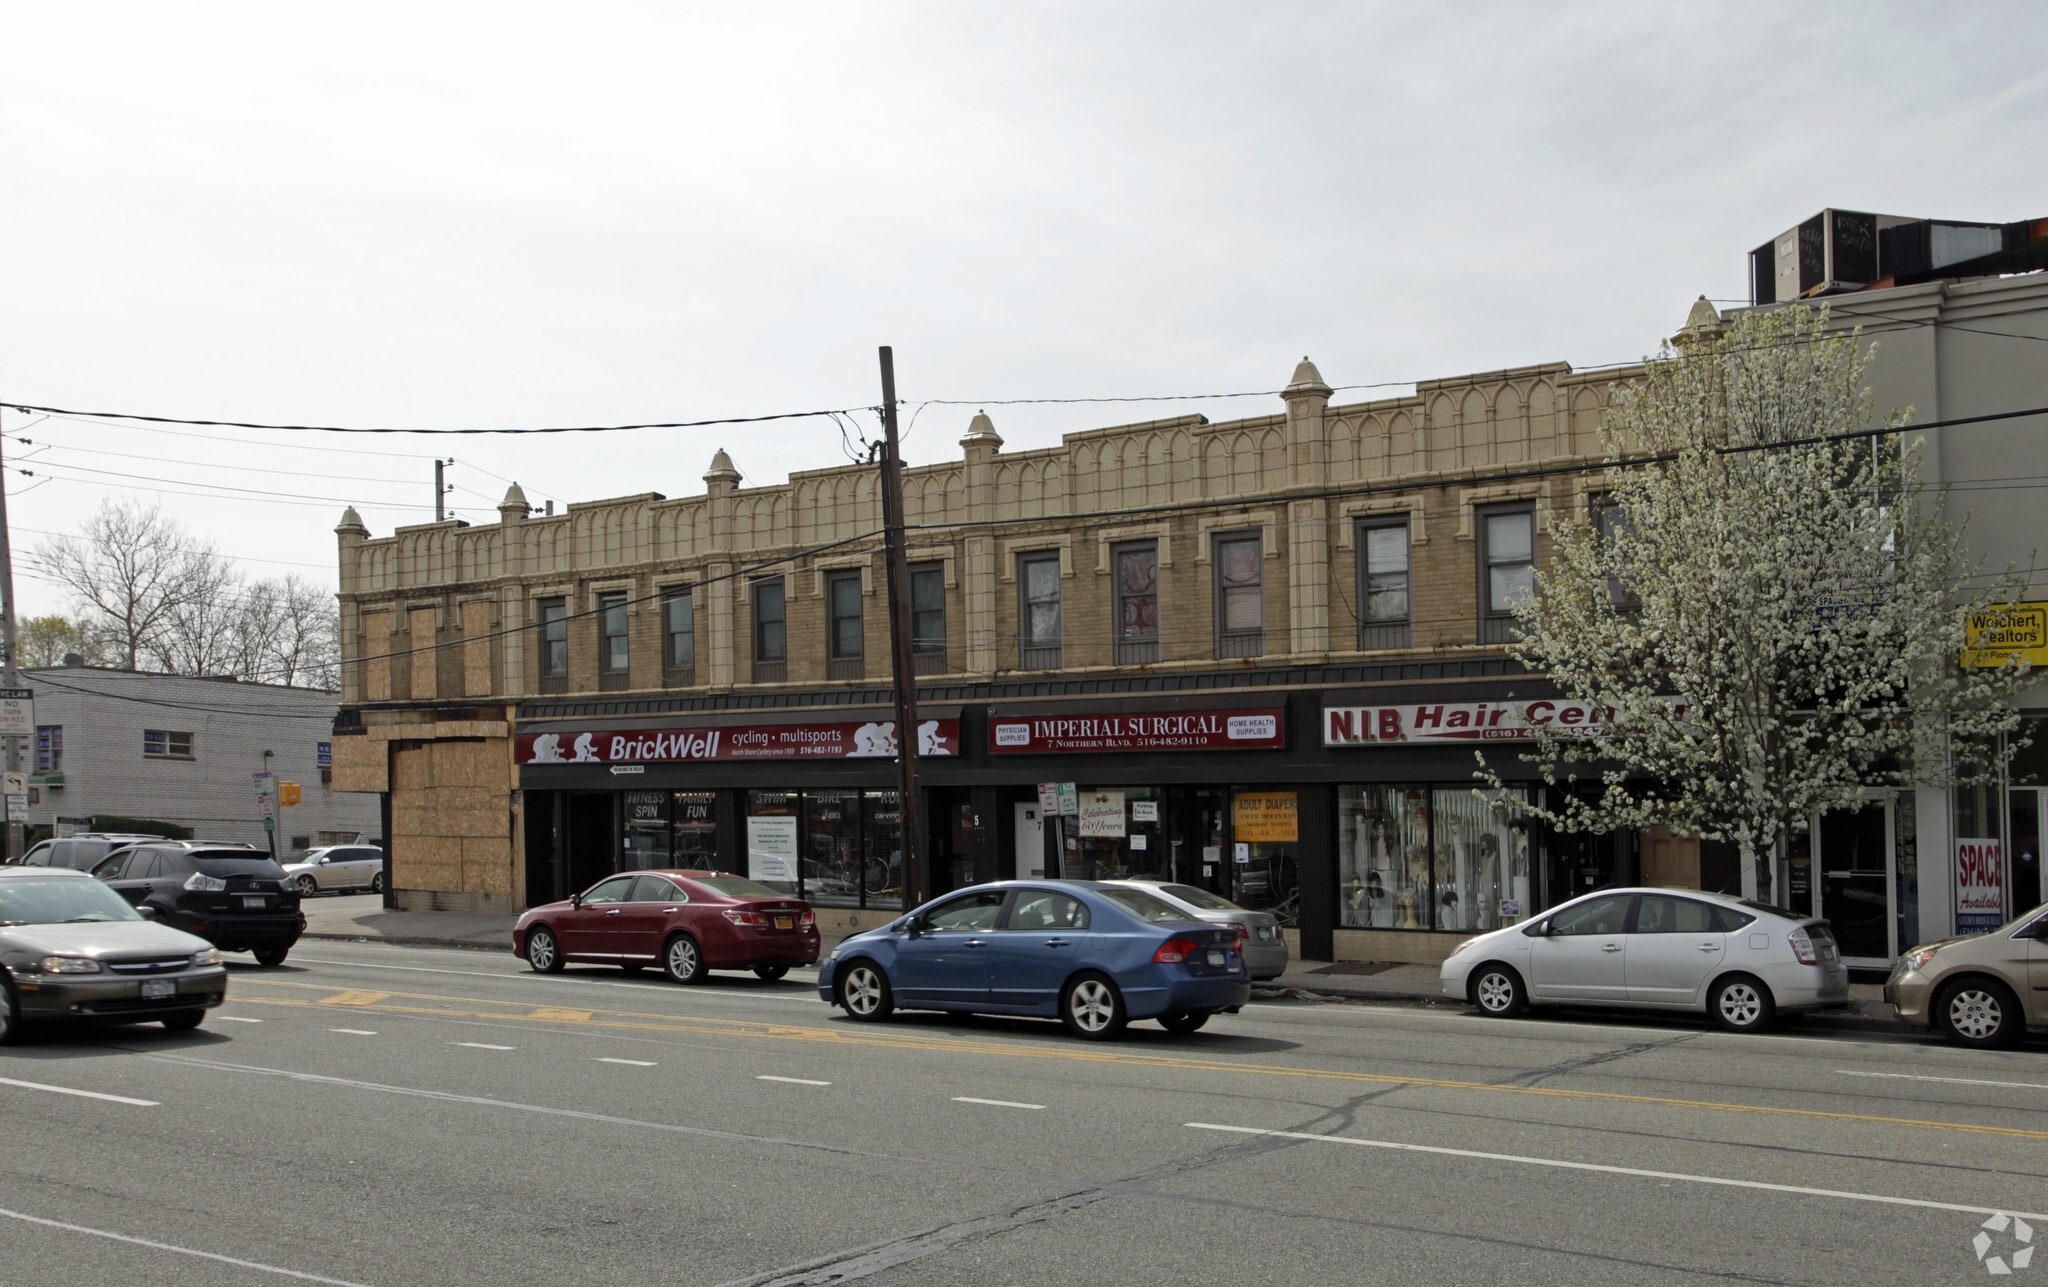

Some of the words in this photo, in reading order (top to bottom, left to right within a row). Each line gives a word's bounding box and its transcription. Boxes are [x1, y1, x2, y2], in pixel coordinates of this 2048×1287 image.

[5, 700, 19, 708] NO
[1034, 719, 1125, 738] IMPERIAL
[1128, 714, 1223, 736] SURGICAL
[1249, 719, 1274, 727] HEALTH
[1330, 709, 1406, 742] N.I.B.
[1414, 703, 1508, 729] Hair
[998, 726, 1028, 734] PHYSICIAN
[1236, 727, 1268, 736] SUPPLIES
[1485, 729, 1517, 738] (516)
[732, 731, 769, 744] cycling
[780, 729, 842, 742] multisports
[1000, 734, 1026, 742] SUPPLIES
[1047, 739, 1053, 748] 7
[1136, 736, 1208, 747] 516-482-9110
[609, 731, 721, 760] BrickWell
[800, 745, 842, 754] 516-482-1193
[627, 791, 665, 804] FITNESS
[756, 791, 787, 804] SWIM
[817, 791, 842, 804] BIKE
[1238, 799, 1262, 810] ADULT
[636, 805, 658, 818] SPIN
[686, 805, 708, 818] FUN
[1081, 806, 1122, 820] Celebrating
[973, 814, 979, 826] 5
[1036, 821, 1042, 831] 7
[1960, 891, 2001, 910] Availabl
